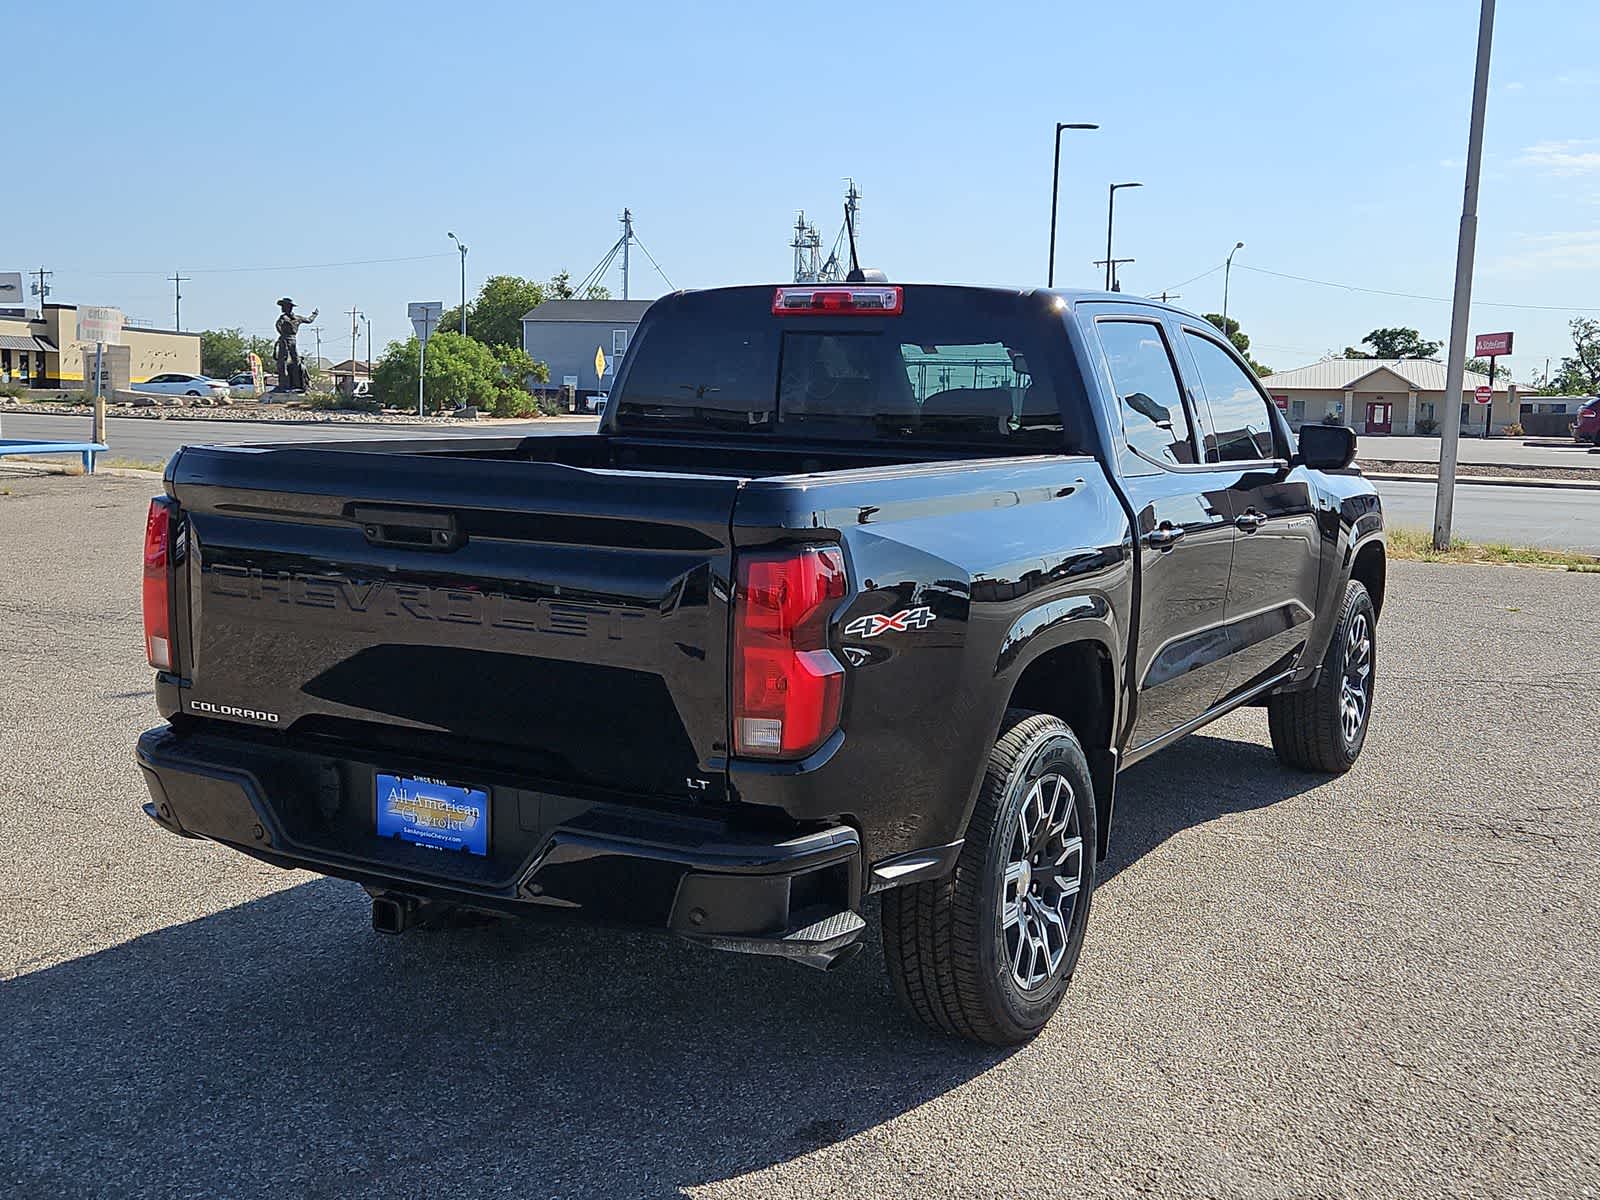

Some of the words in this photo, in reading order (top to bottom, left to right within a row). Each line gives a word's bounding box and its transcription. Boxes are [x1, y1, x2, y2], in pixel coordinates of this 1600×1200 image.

[210, 563, 645, 640] CHEVROLET
[191, 700, 279, 722] COLORADO
[686, 777, 710, 790] LT
[388, 787, 408, 803] All
[412, 791, 481, 818] American
[401, 805, 465, 832] Chevrolet
